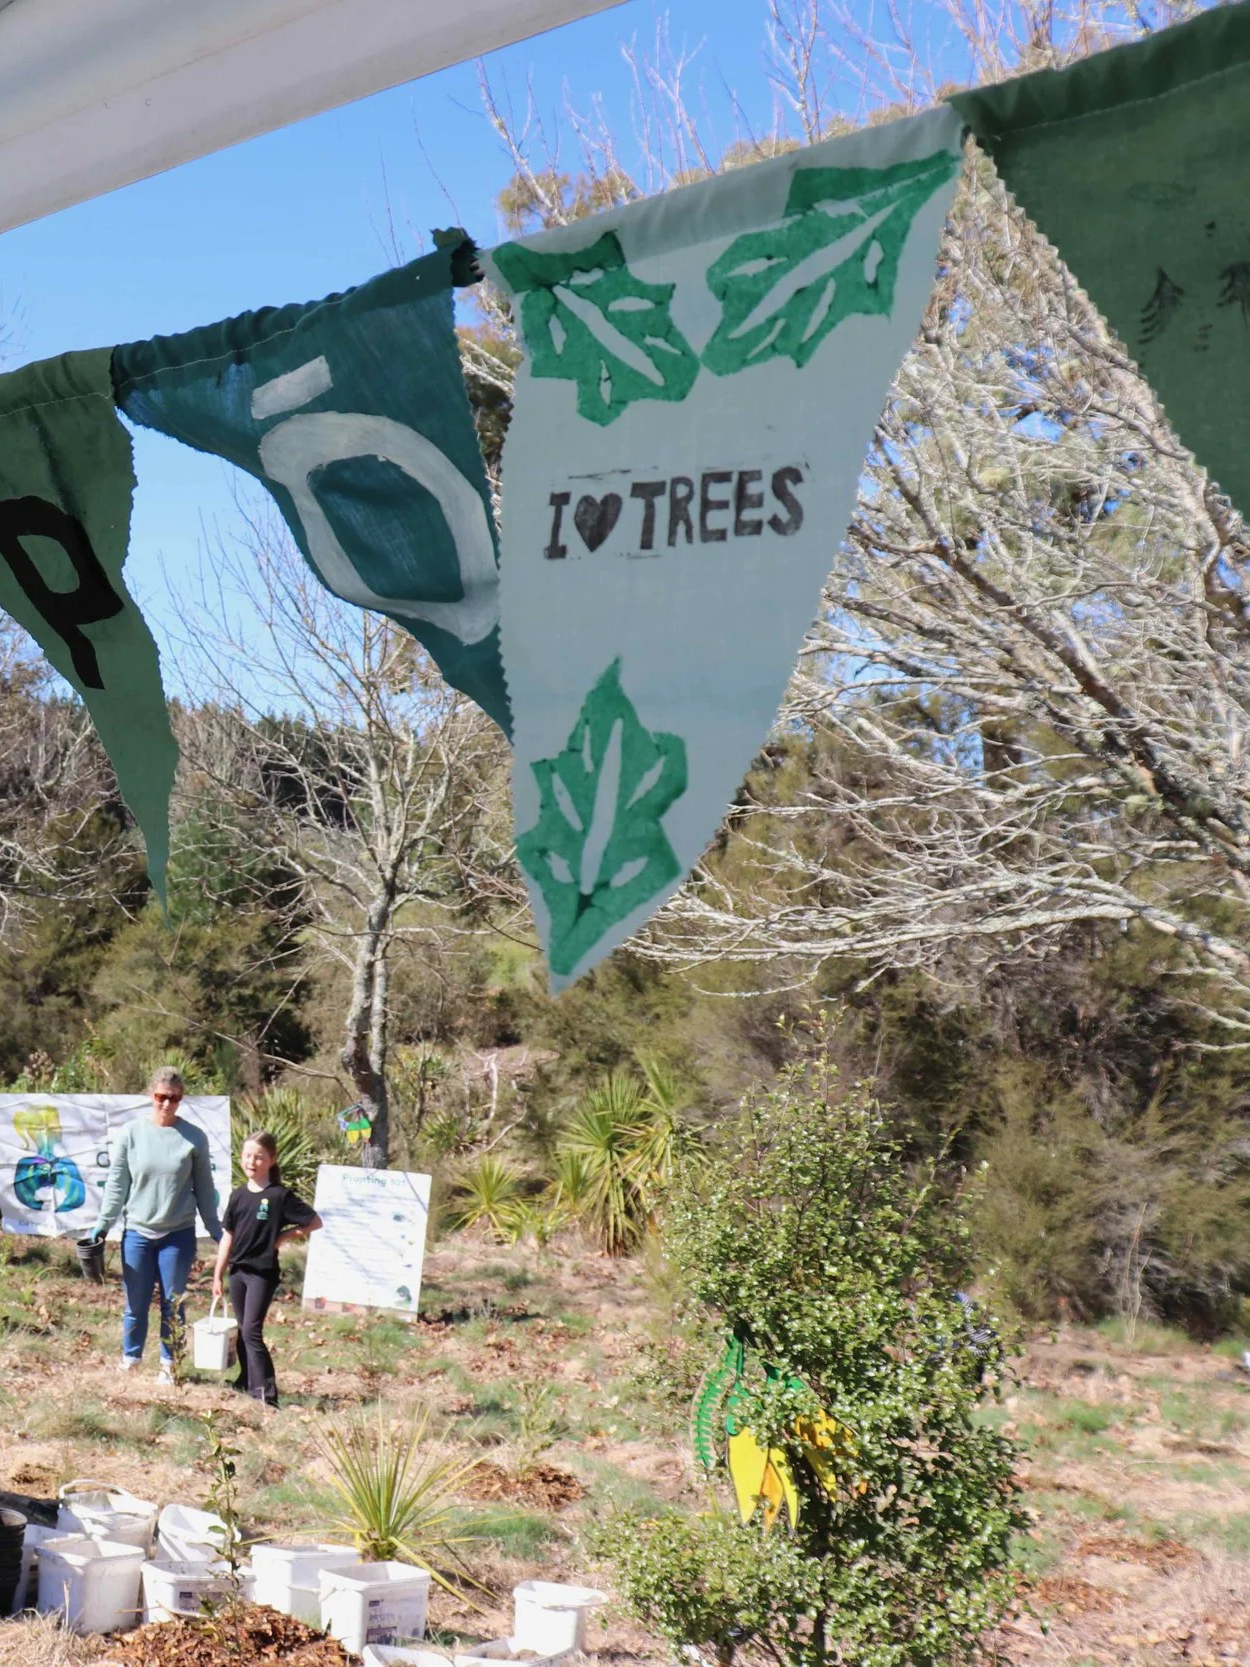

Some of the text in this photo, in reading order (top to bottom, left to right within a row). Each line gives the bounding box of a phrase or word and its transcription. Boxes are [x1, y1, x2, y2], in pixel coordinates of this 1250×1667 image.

[543, 465, 805, 561] I TREES
[342, 1173, 387, 1188] Planting
